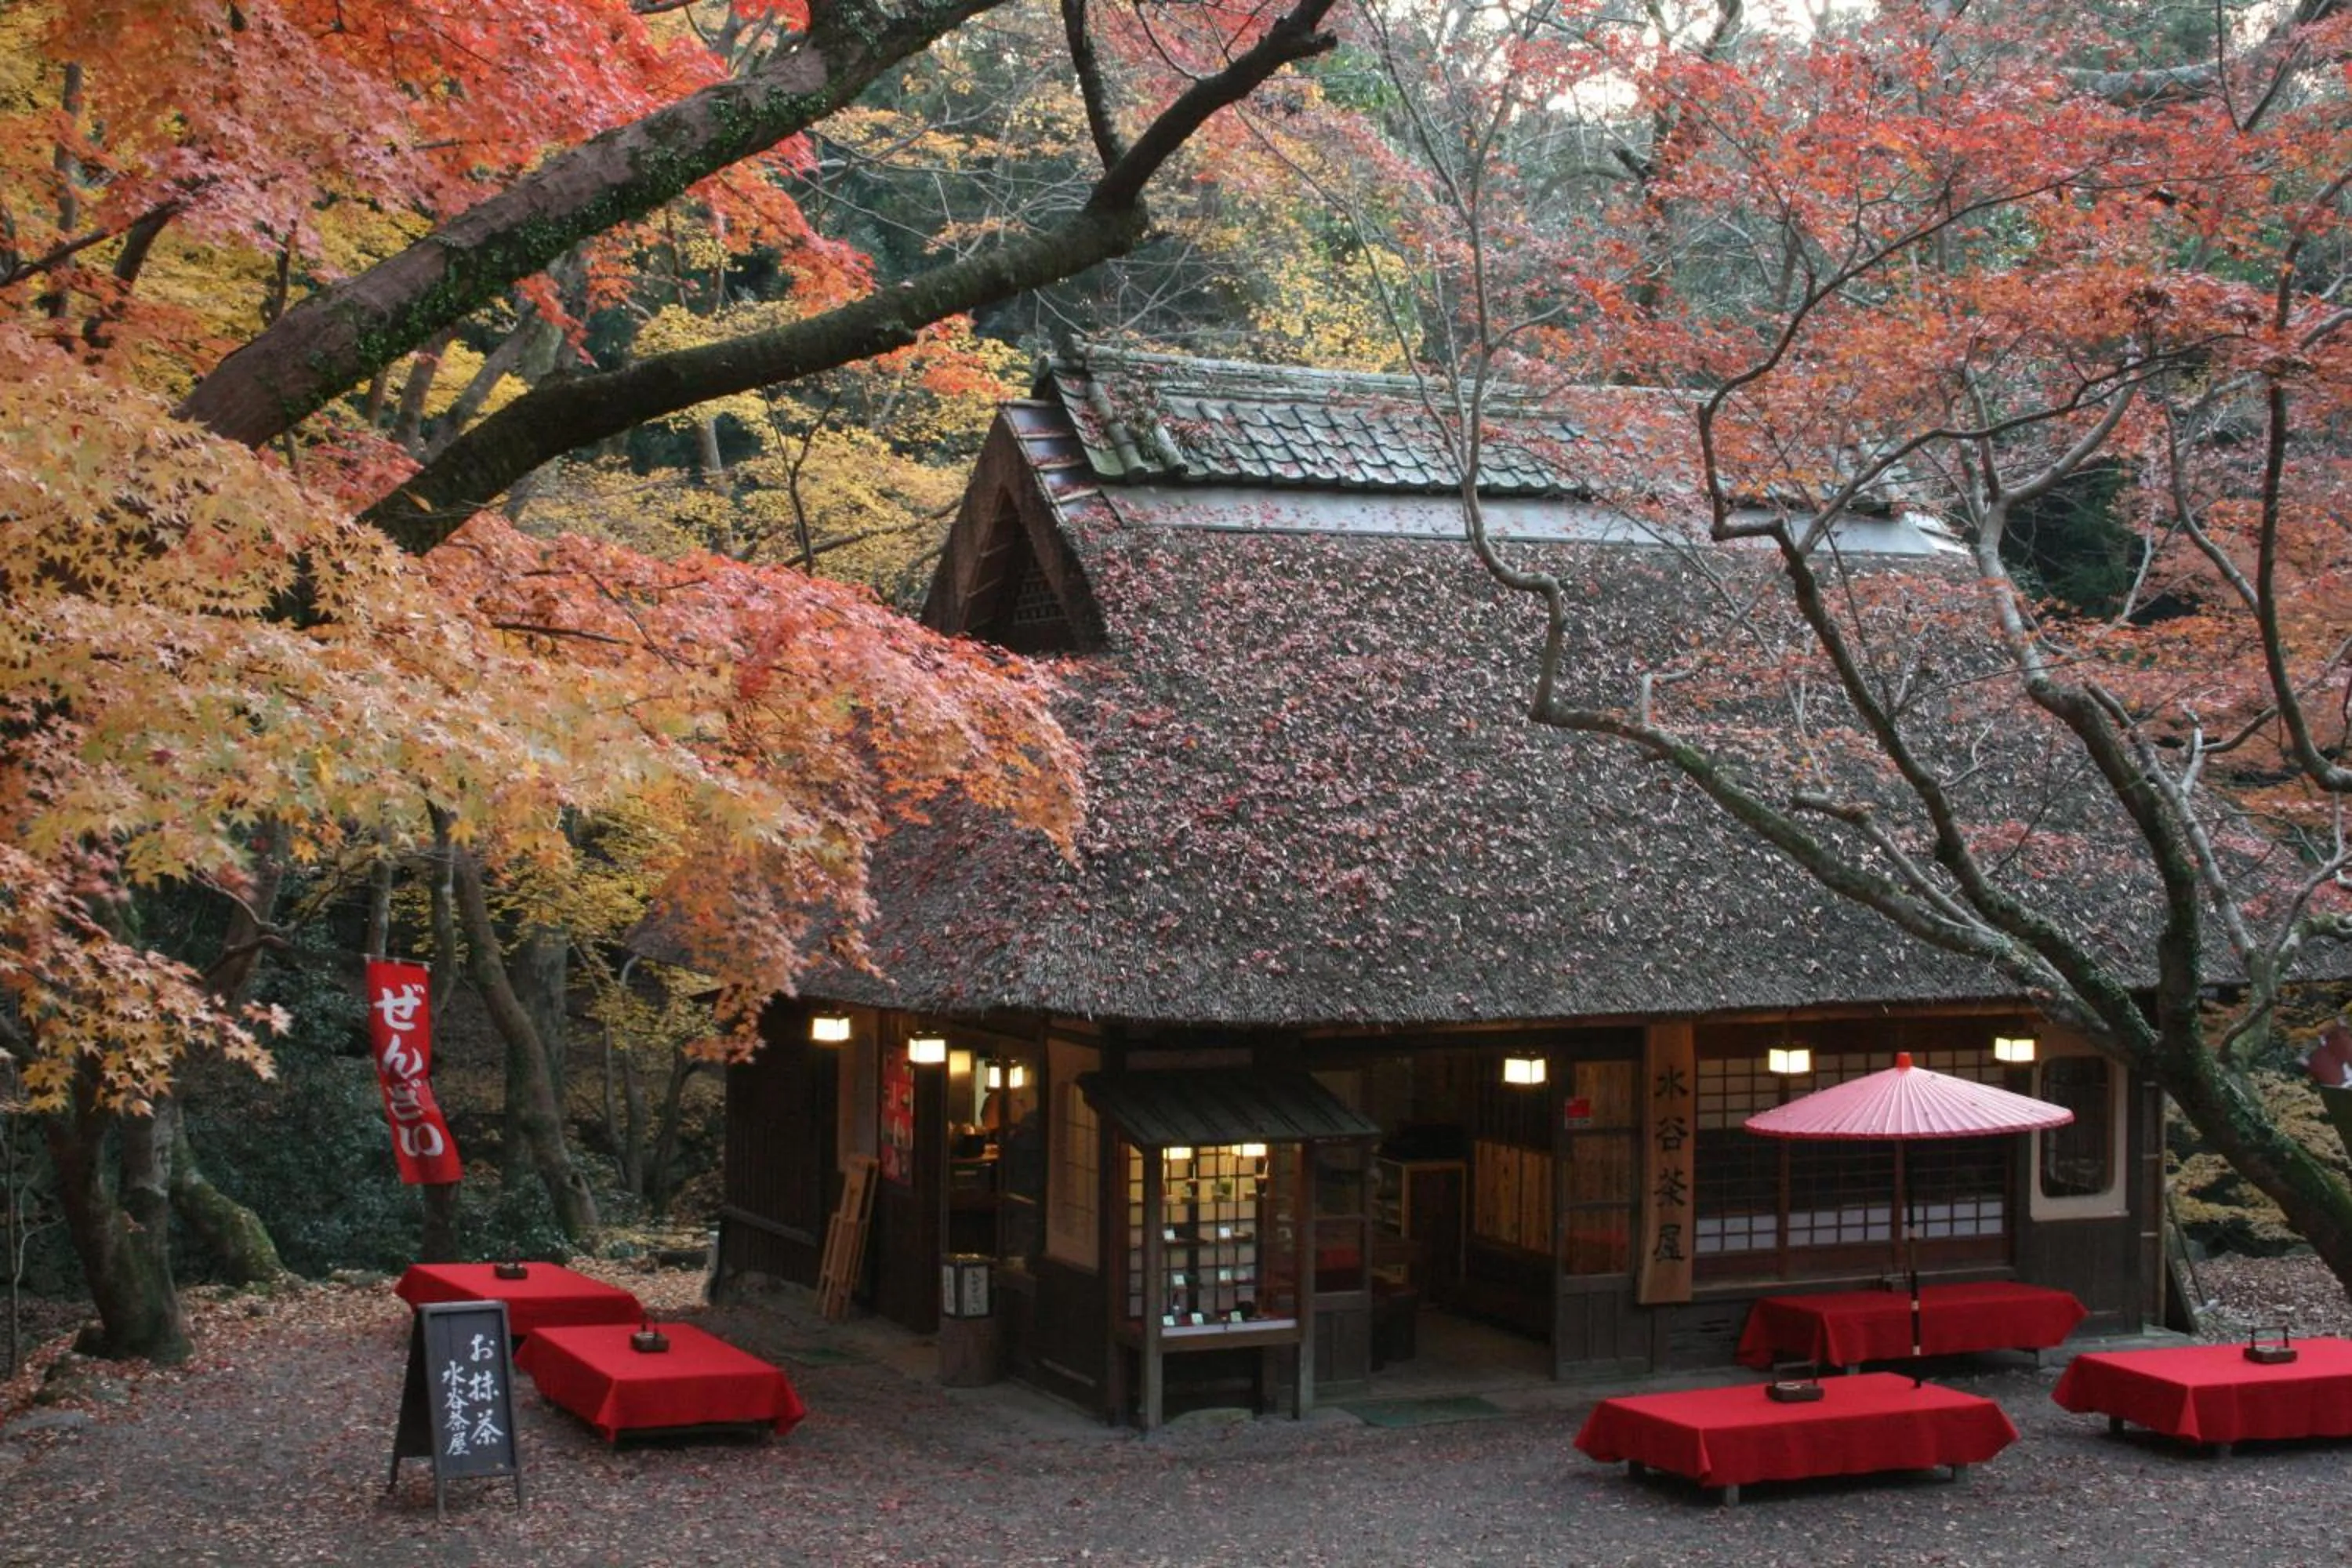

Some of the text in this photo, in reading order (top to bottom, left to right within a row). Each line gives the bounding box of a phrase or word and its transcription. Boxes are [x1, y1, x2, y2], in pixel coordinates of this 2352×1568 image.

[373, 983, 445, 1157] ぜんざい
[1653, 1064, 1689, 1262] 水谷茶屋
[441, 1360, 471, 1457] 水谷茶屋
[467, 1333, 506, 1446] お抹茶
